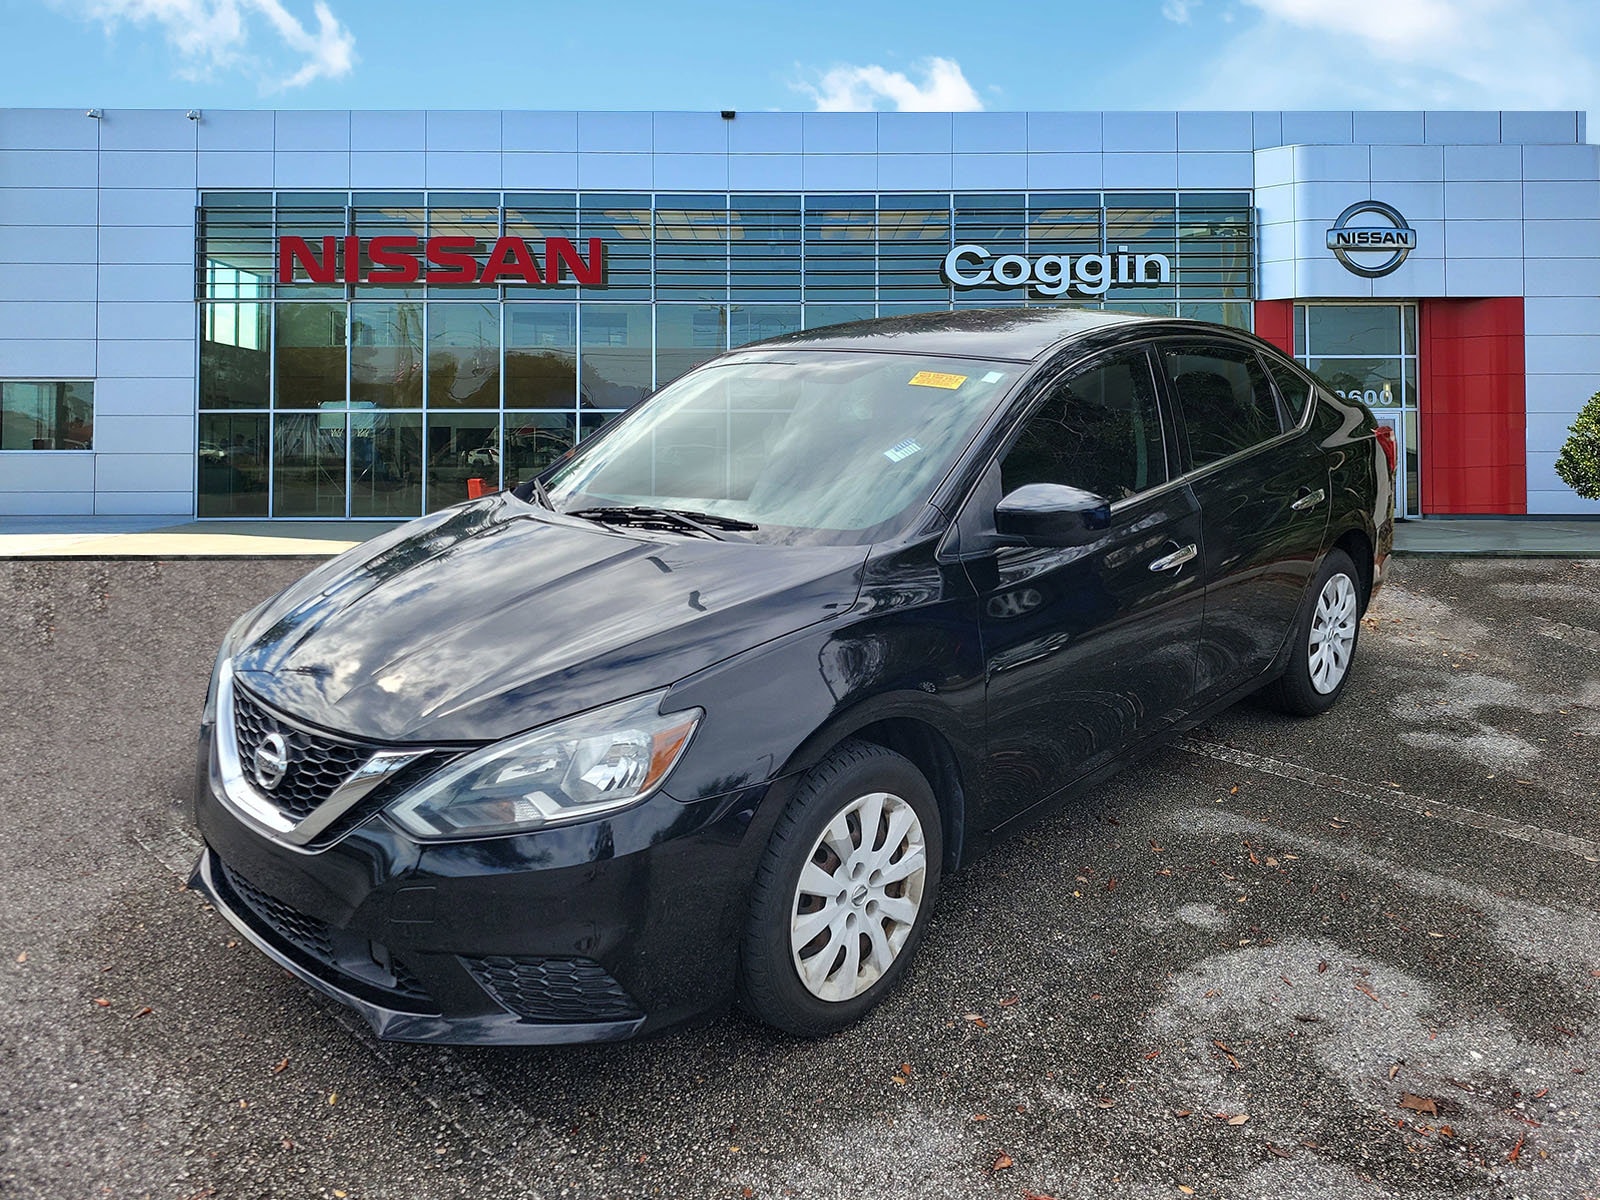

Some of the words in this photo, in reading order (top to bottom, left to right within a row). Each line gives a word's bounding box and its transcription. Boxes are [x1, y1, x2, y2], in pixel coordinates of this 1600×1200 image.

[279, 236, 602, 283] NISSAN
[1336, 232, 1408, 245] NISSAN
[944, 244, 1171, 295] Coggin
